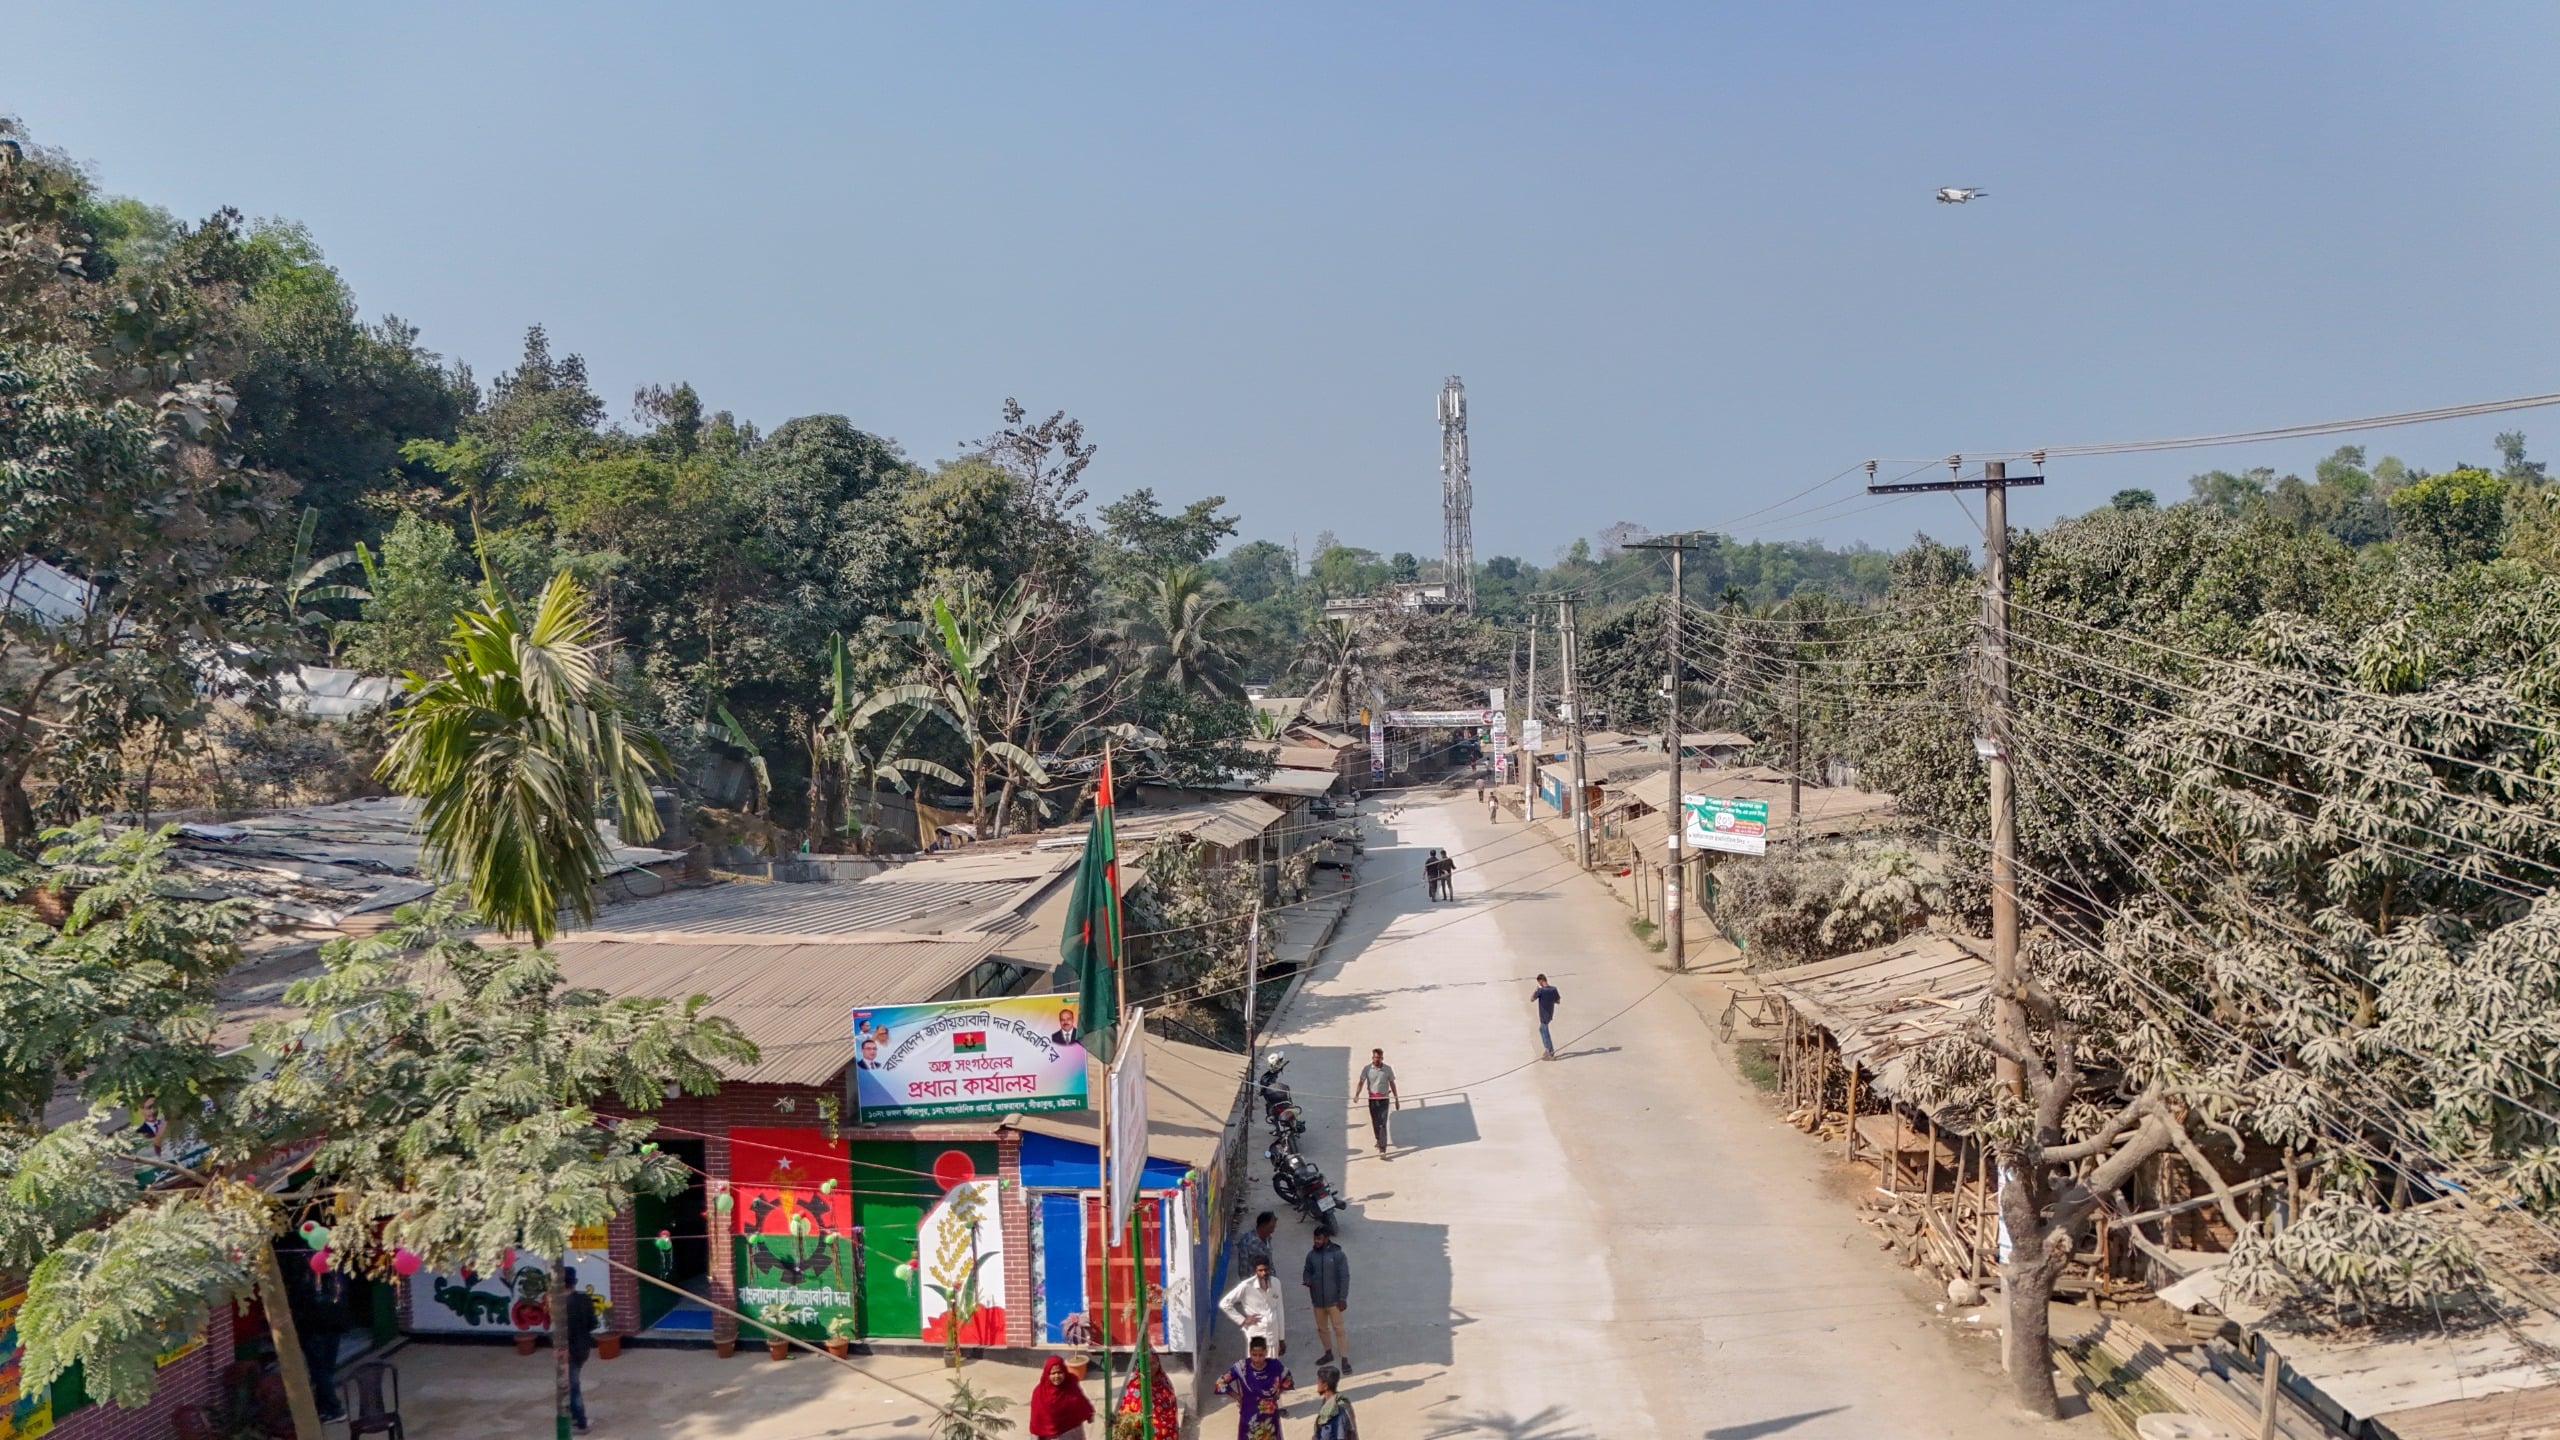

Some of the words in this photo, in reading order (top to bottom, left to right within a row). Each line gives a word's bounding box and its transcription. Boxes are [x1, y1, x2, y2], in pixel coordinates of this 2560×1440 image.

[883, 1032, 924, 1071] বাংলাদেশ
[925, 1010, 991, 1038] জাতীয়তাবাদী
[992, 1016, 1010, 1032] দল
[928, 1060, 951, 1074] অঙ্গ
[956, 1054, 1013, 1072] সংগঠনের
[908, 1079, 957, 1099] প্রধান
[962, 1072, 1037, 1096] কার্যালয়
[738, 1286, 779, 1305] বাংলাদেশ
[834, 1291, 851, 1308] দল
